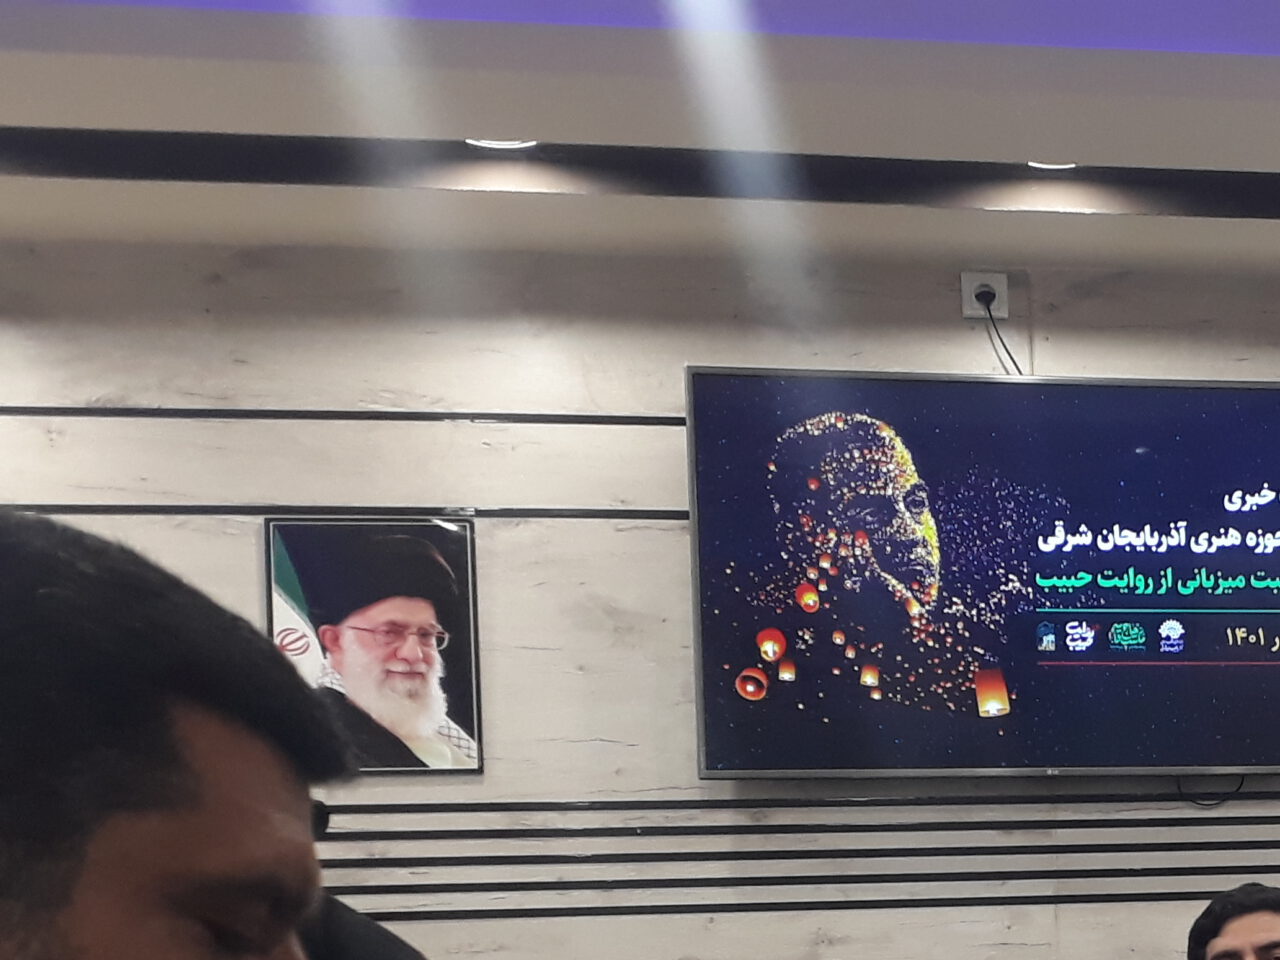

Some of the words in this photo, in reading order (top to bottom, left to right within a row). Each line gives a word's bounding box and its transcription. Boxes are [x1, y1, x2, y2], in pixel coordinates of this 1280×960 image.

[1224, 482, 1277, 511] خبری
[1037, 520, 1093, 552] شرقی
[1096, 521, 1187, 552] آذربایجان
[1190, 527, 1242, 553] هنری
[1035, 571, 1093, 593] حبیب
[1097, 567, 1153, 594] روایت
[1157, 567, 1173, 594] از
[1177, 568, 1245, 595] میزبانی
[1226, 627, 1265, 646] ۱۴۰۱
